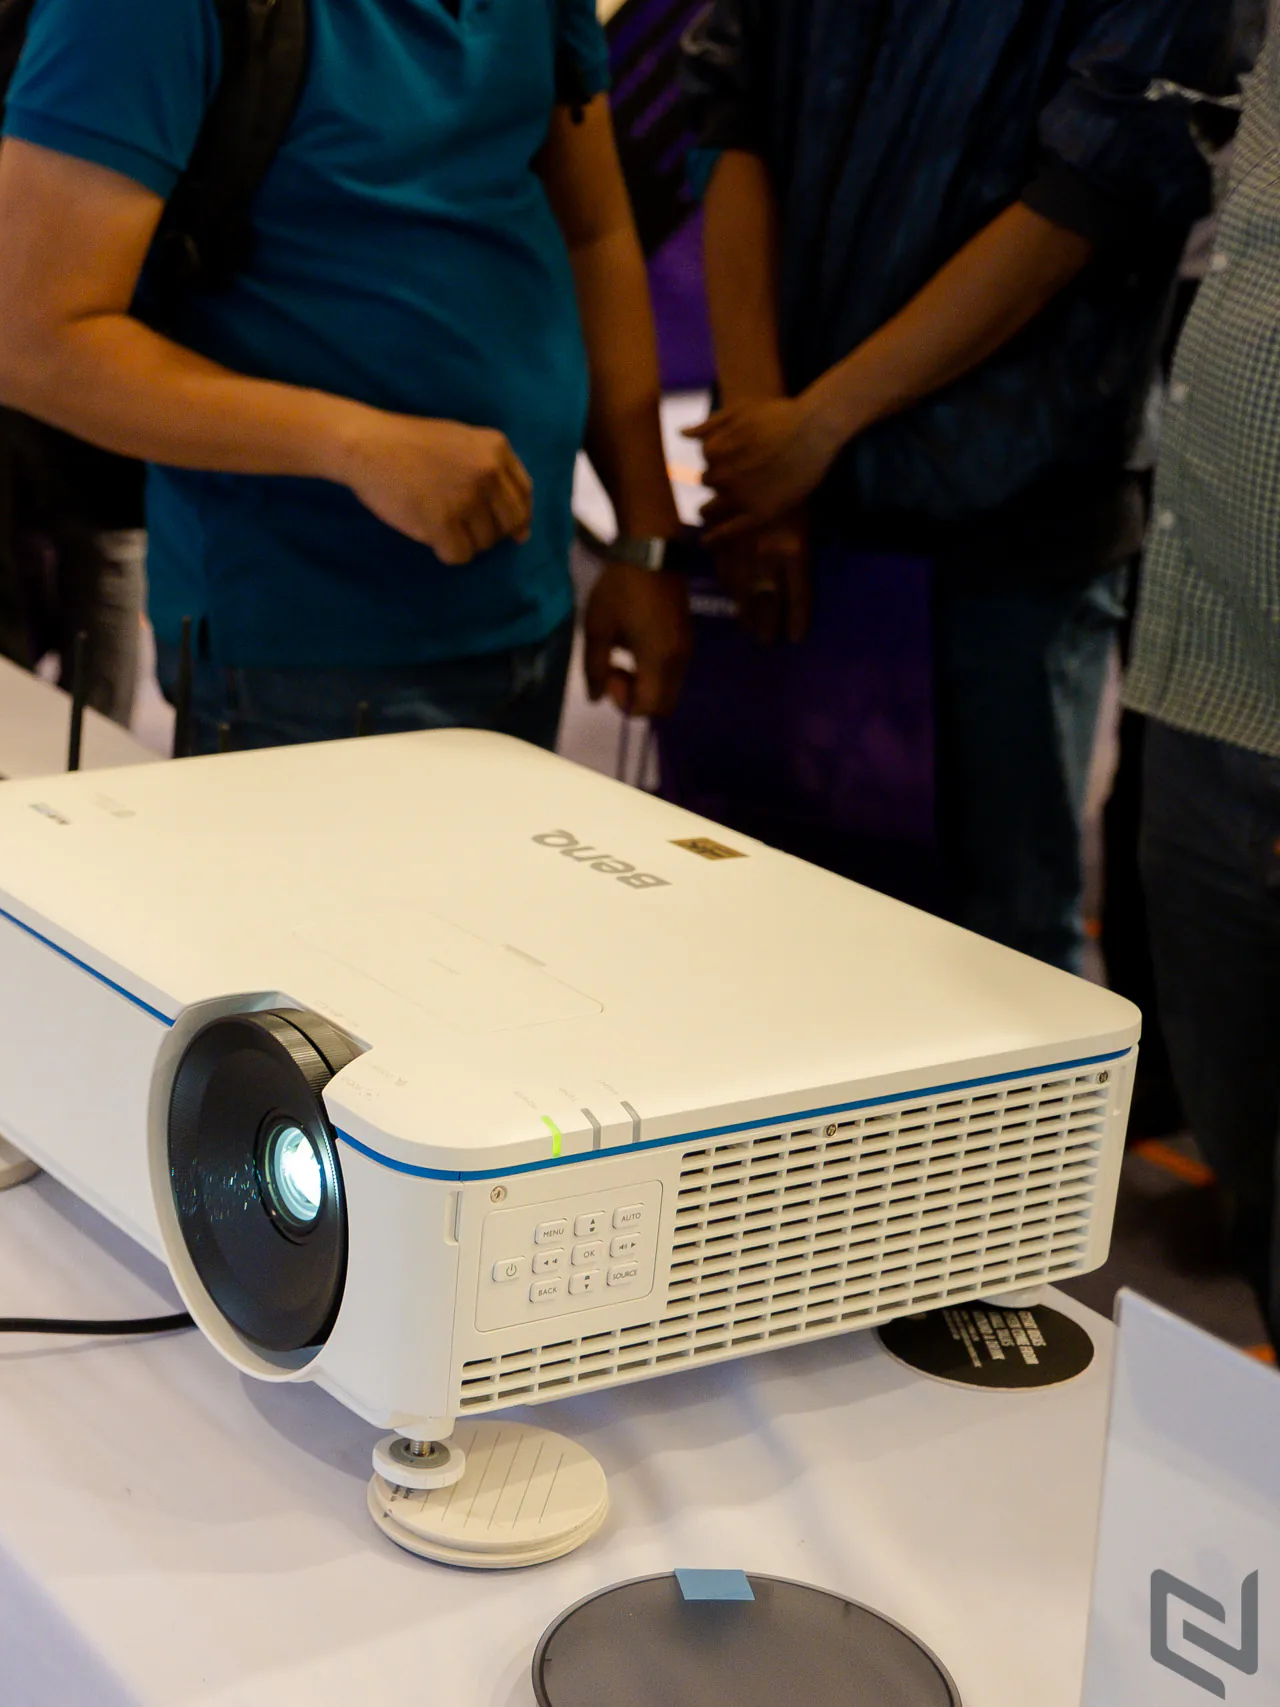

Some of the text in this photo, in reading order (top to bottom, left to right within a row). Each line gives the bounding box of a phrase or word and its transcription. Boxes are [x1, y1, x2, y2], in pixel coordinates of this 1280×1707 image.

[531, 829, 672, 889] BenQ
[620, 1212, 642, 1223] AUTO
[542, 1228, 565, 1238] MENU
[582, 1249, 596, 1259] OK
[612, 1269, 638, 1281] SOURCE
[537, 1287, 558, 1297] BACK
